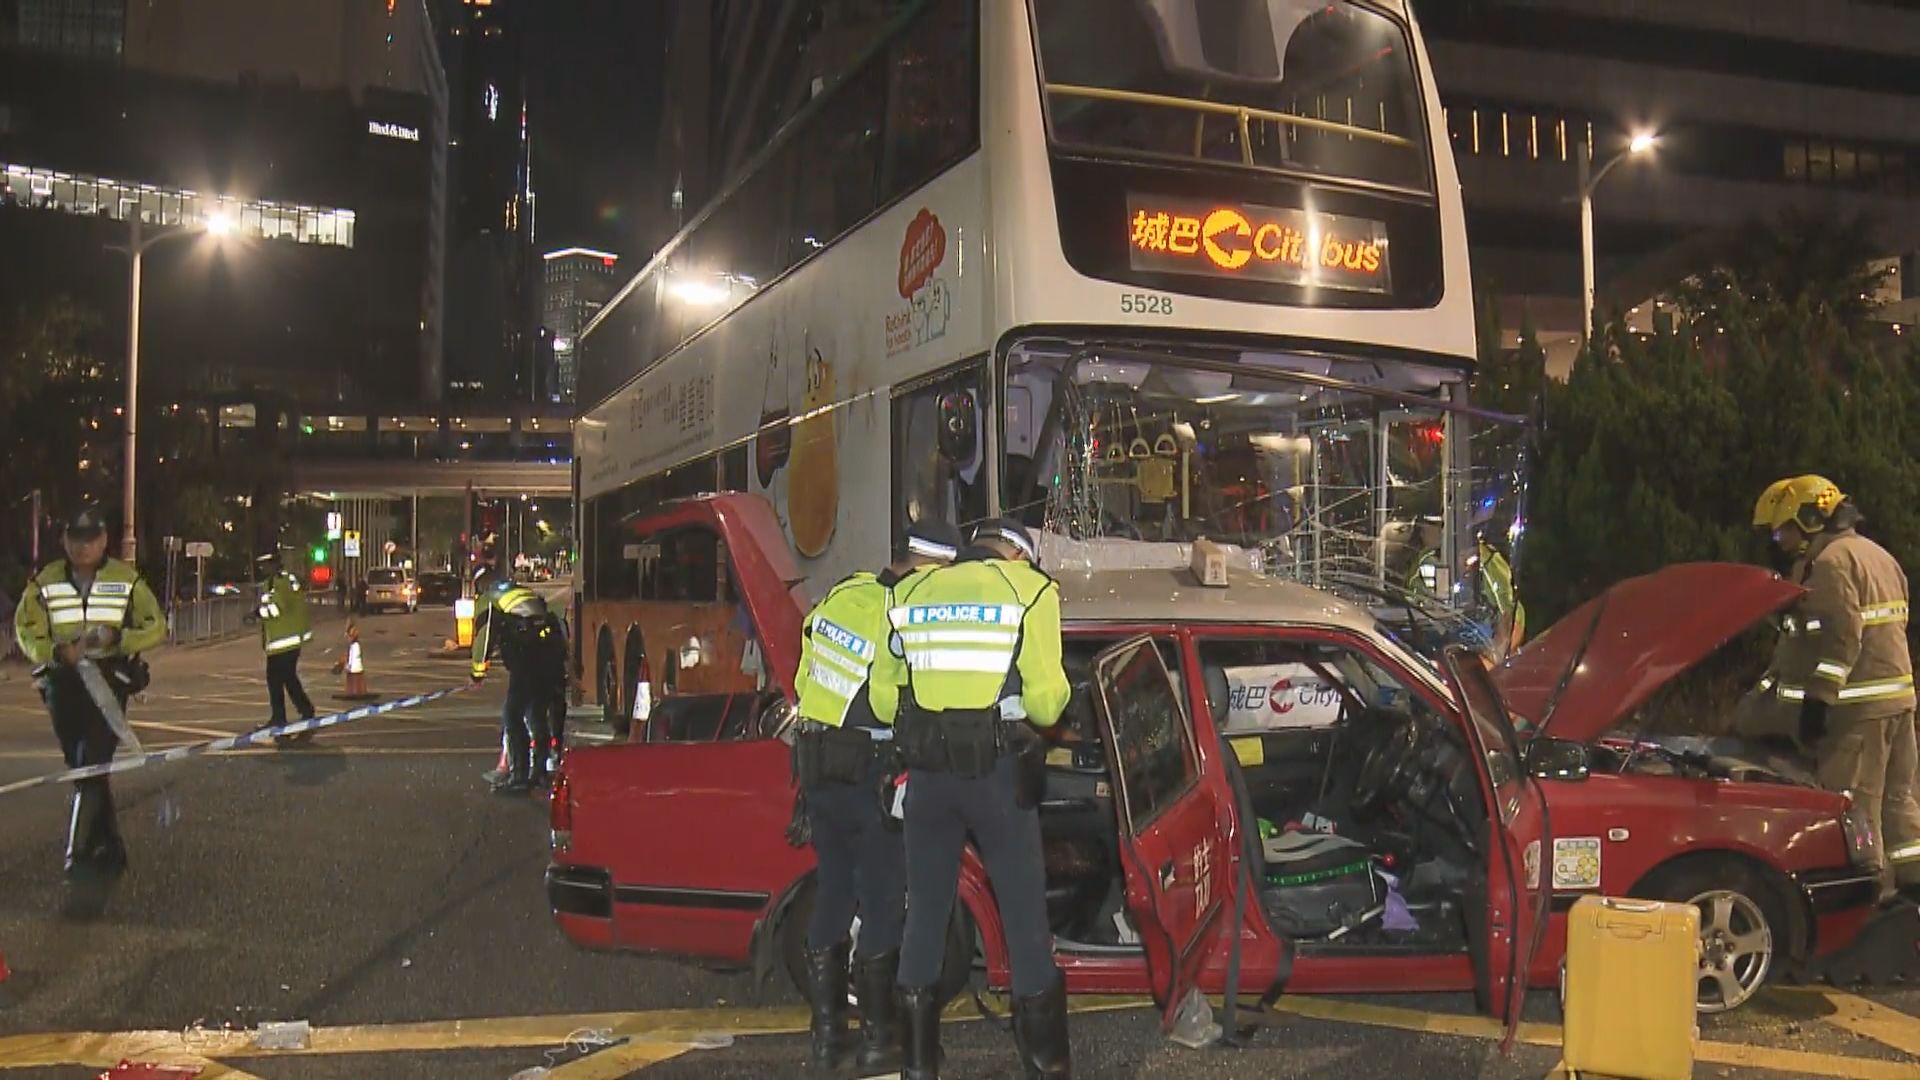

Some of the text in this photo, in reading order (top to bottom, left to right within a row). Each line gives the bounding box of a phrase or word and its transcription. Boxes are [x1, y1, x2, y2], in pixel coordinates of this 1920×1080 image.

[1131, 209, 1201, 254] 城巴
[1121, 294, 1174, 316] 5528
[926, 606, 979, 622] POLICE
[823, 622, 852, 648] POLICE
